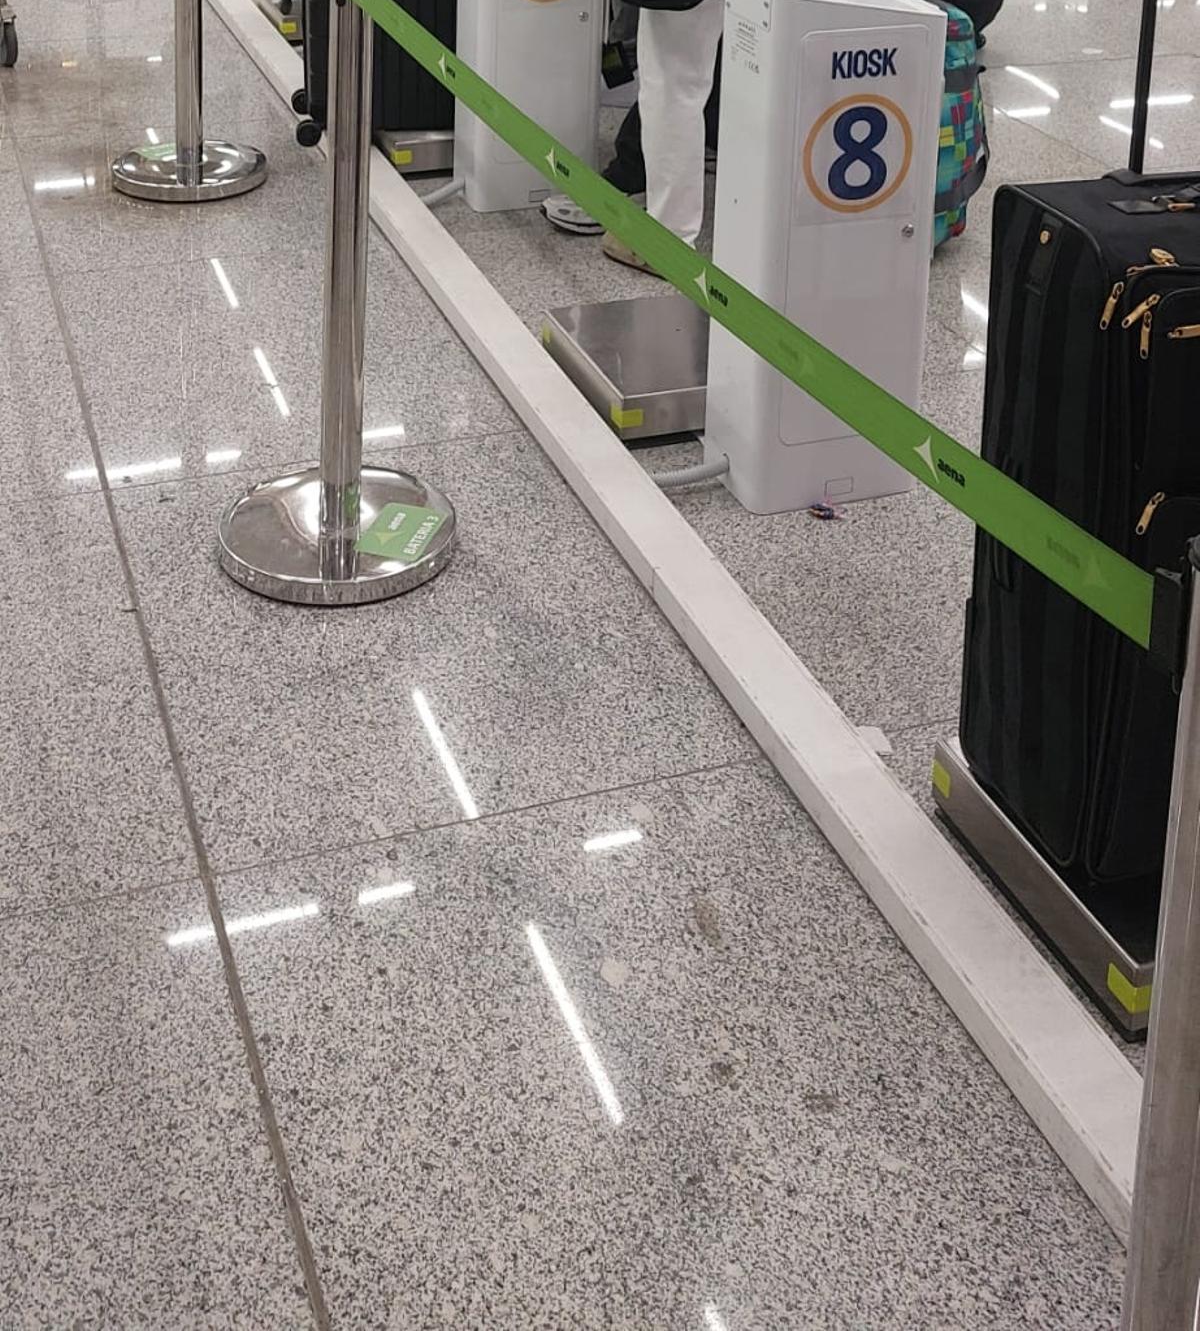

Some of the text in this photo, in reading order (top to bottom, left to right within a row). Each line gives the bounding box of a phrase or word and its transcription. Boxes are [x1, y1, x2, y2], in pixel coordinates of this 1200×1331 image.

[831, 48, 898, 80] KIOSK
[828, 105, 888, 200] 8
[937, 458, 966, 488] aena
